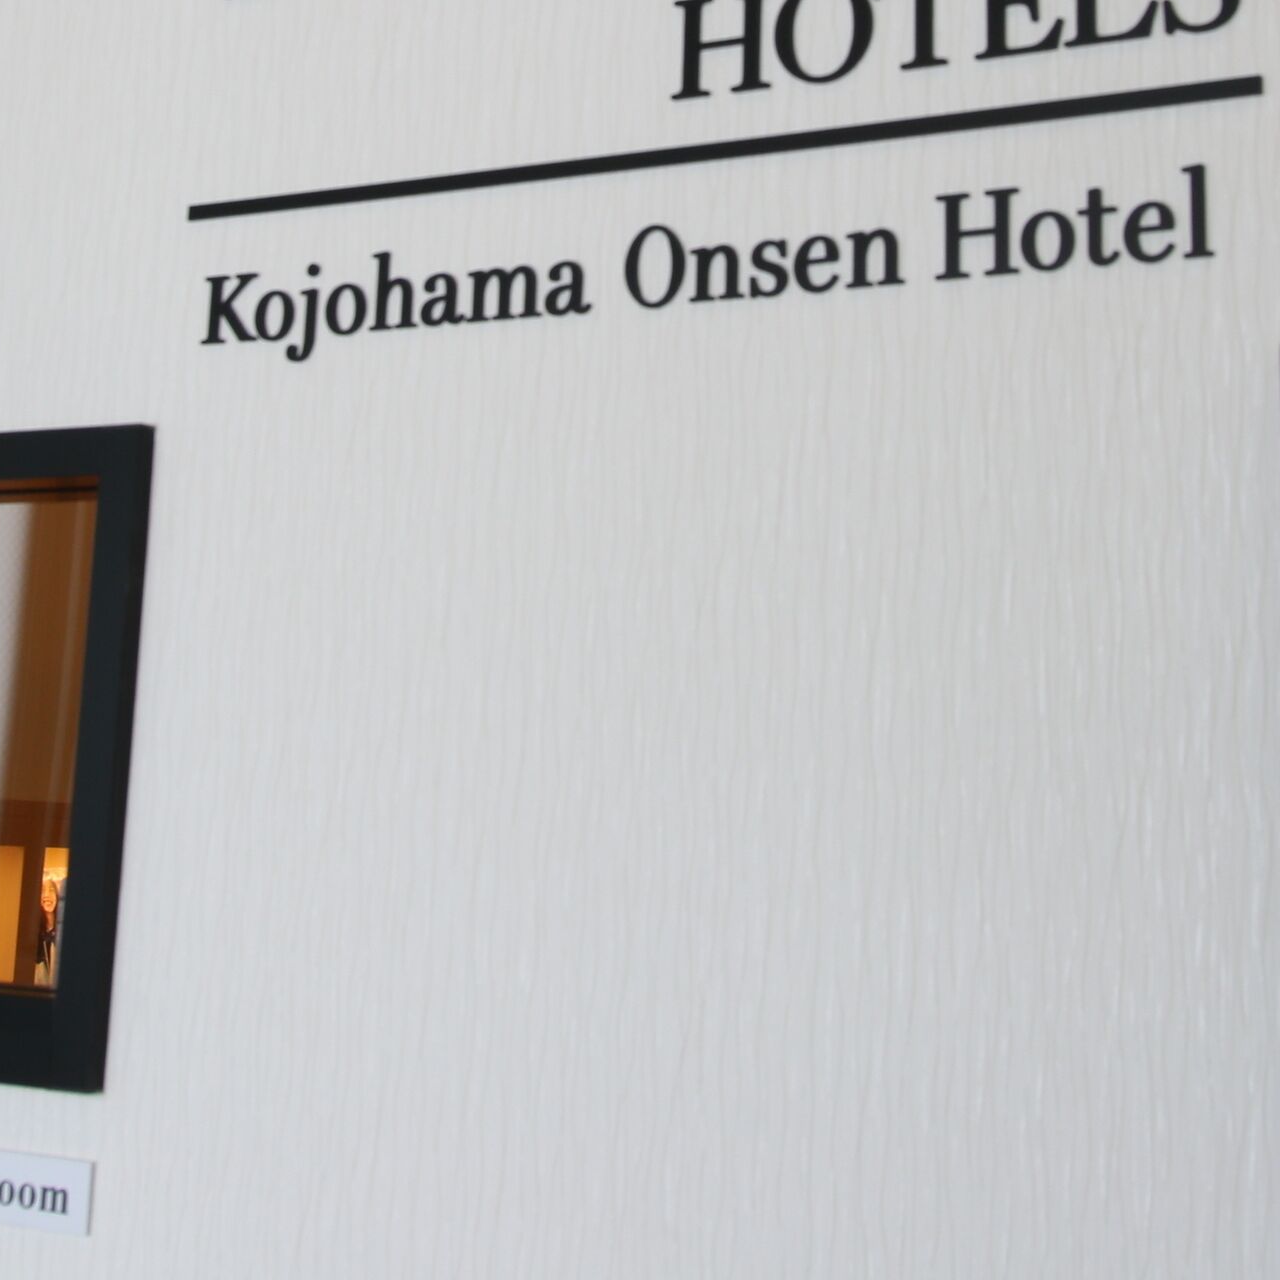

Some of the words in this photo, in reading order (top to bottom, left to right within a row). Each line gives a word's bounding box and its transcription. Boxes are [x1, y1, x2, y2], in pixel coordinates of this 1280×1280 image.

[200, 250, 592, 363] Kojohama
[624, 225, 904, 309] Onsen
[935, 164, 1215, 282] Hotel
